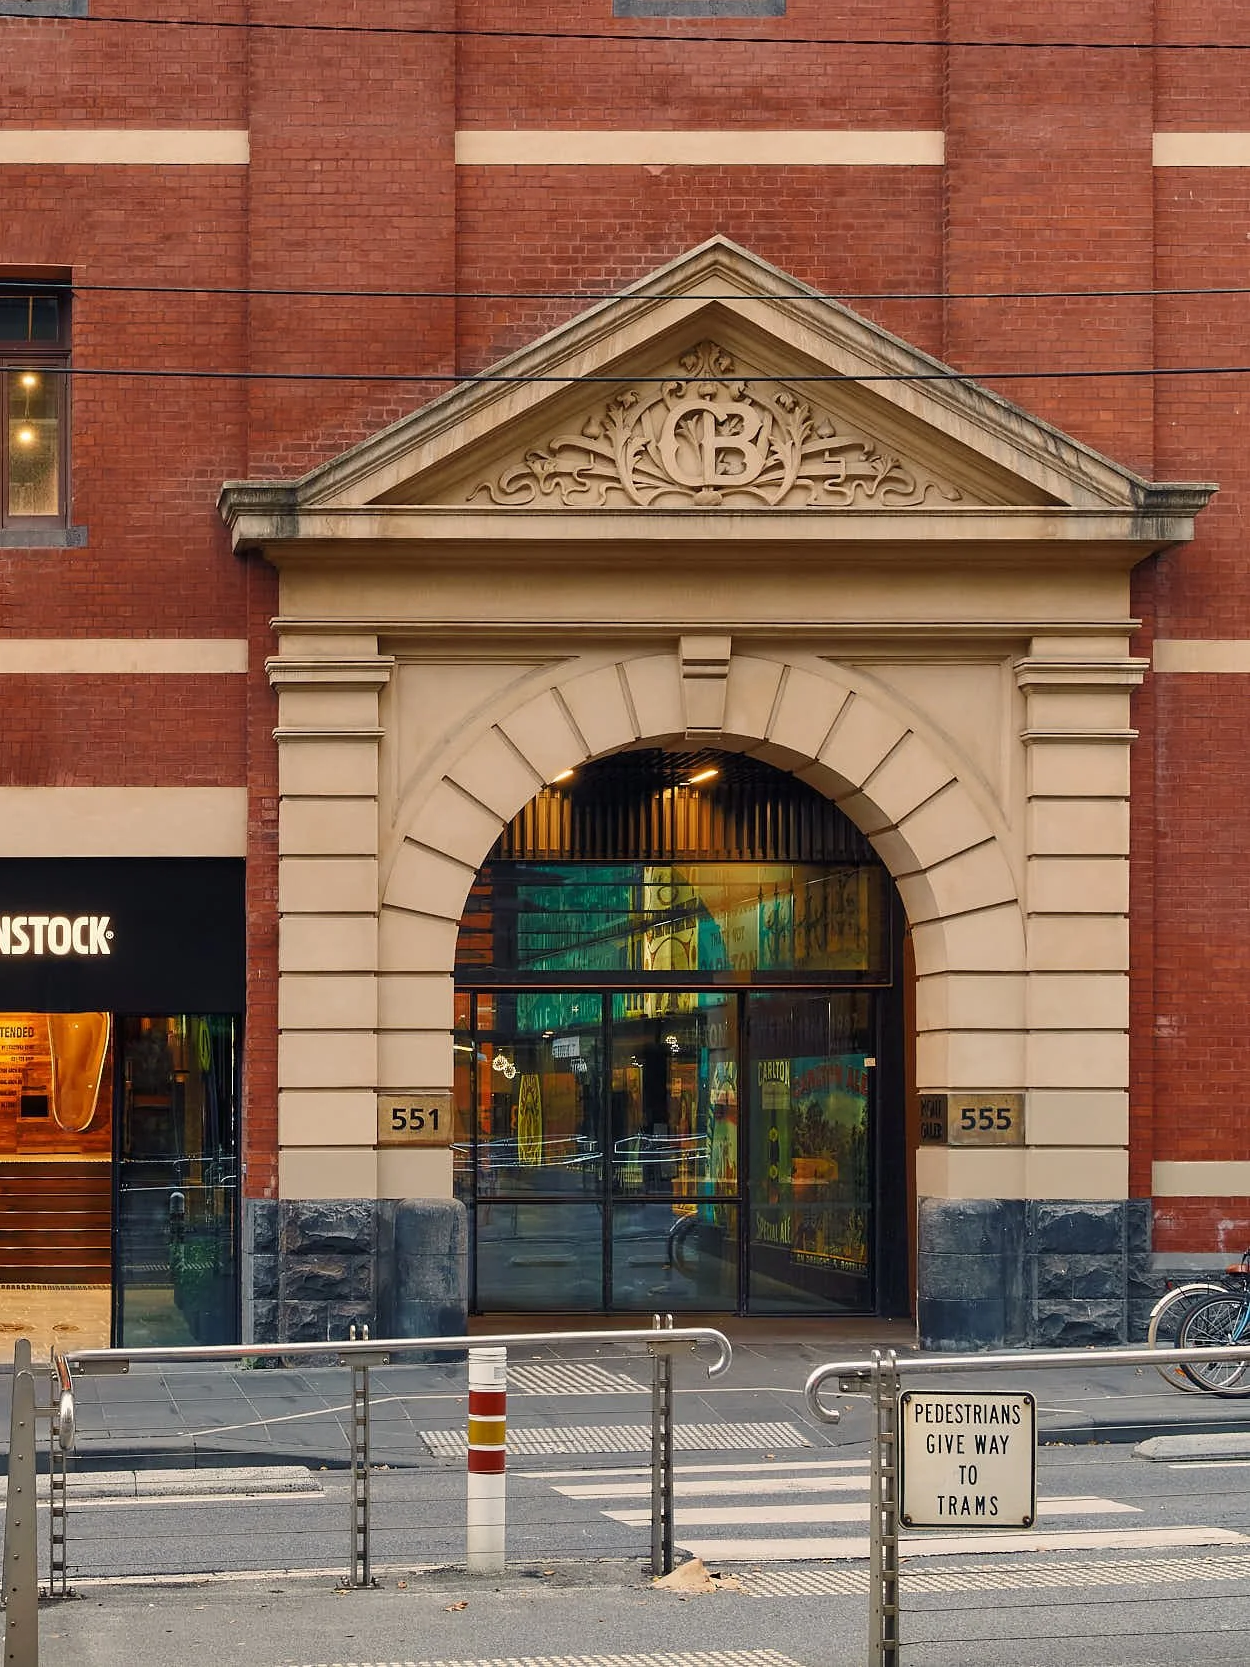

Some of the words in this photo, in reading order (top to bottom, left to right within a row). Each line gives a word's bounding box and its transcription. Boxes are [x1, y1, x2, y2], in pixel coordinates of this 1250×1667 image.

[757, 1061, 791, 1088] CARLTON
[391, 1108, 439, 1131] 551
[961, 1108, 1012, 1131] 555
[914, 1404, 1021, 1425] PEDESTRIANS
[926, 1434, 965, 1455] GIVE
[974, 1434, 1010, 1455] WAY
[958, 1465, 978, 1486] TO
[937, 1495, 999, 1516] TRAMS
